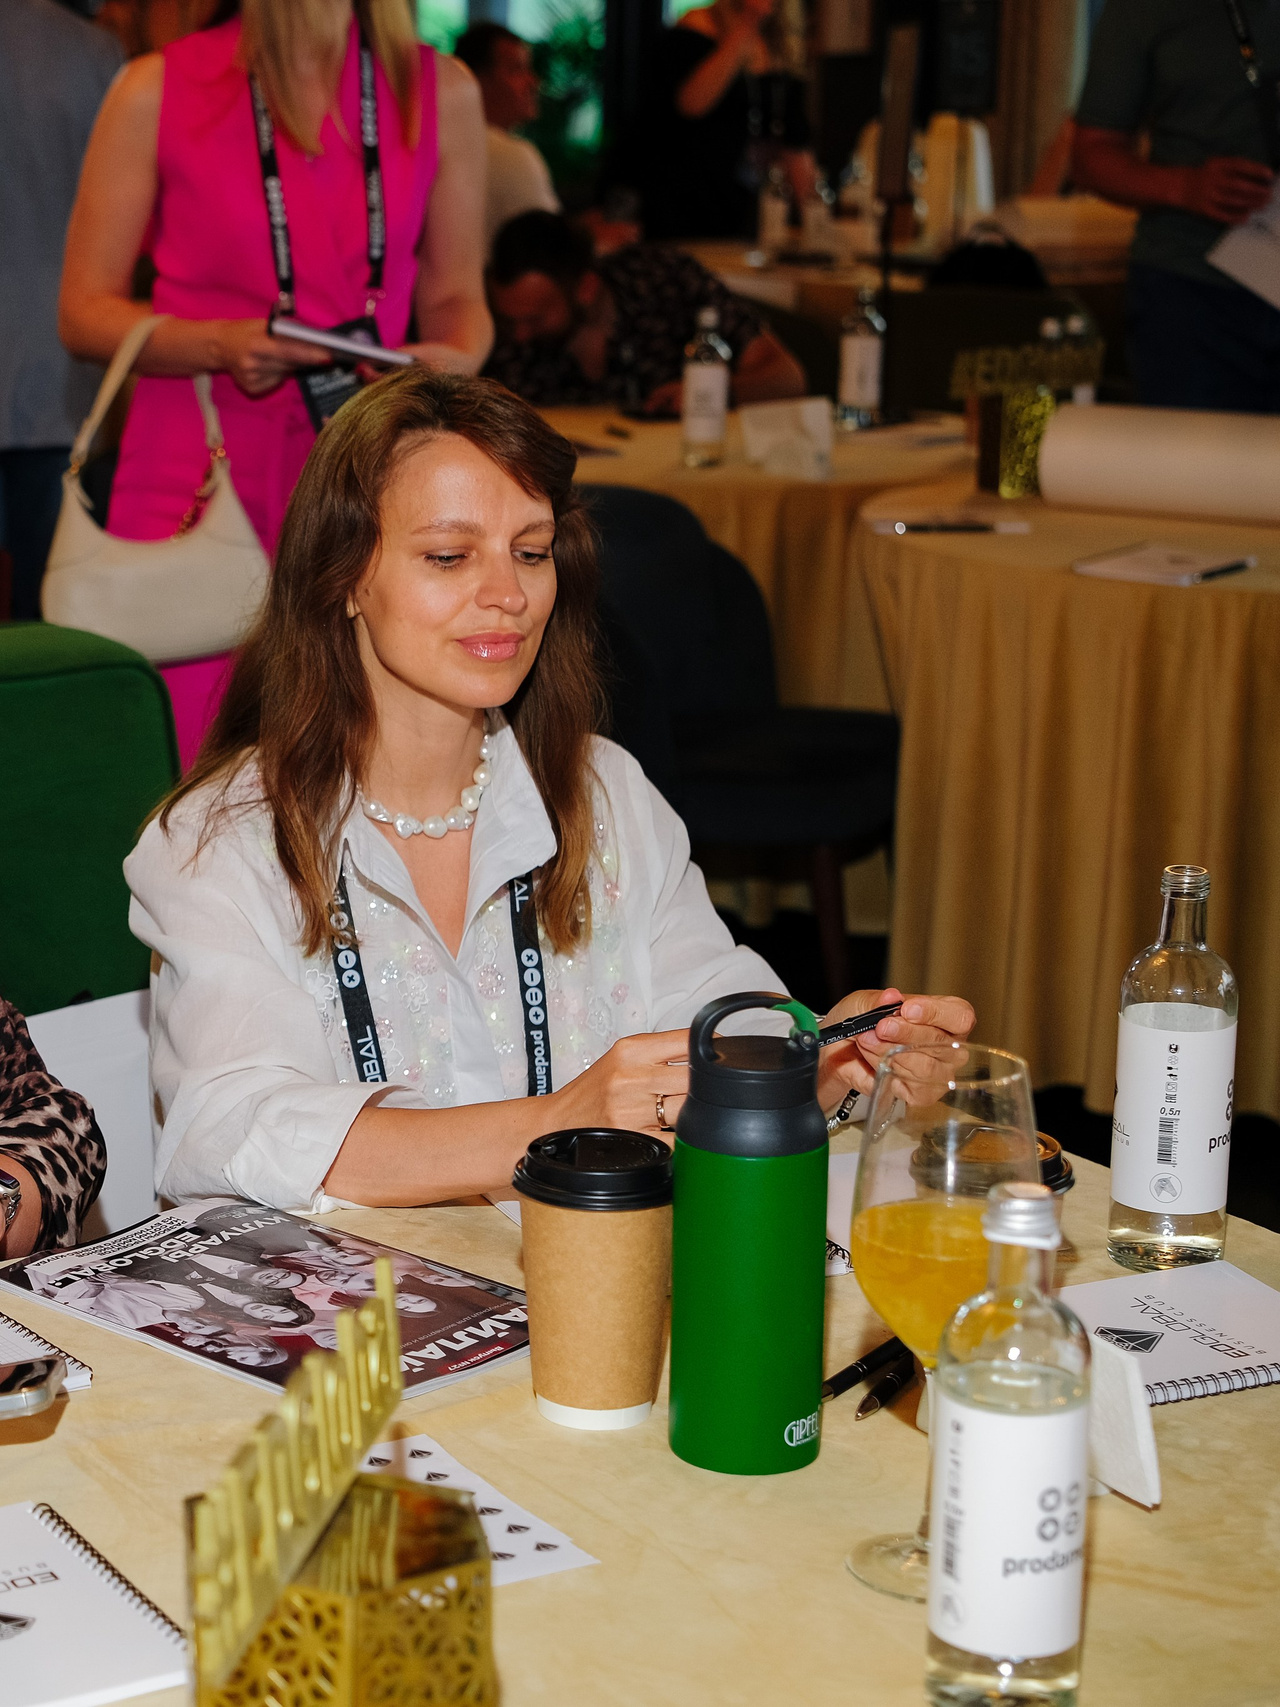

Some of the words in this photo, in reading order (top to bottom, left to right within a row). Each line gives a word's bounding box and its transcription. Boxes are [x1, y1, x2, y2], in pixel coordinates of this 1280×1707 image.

[1160, 1107, 1181, 1116] 0,5л
[161, 1215, 290, 1264] КУЛУАРЫ
[1144, 1294, 1184, 1317] CLUB
[1130, 1297, 1251, 1358] EDGLOBAL
[1187, 1317, 1267, 1355] BUSINESS
